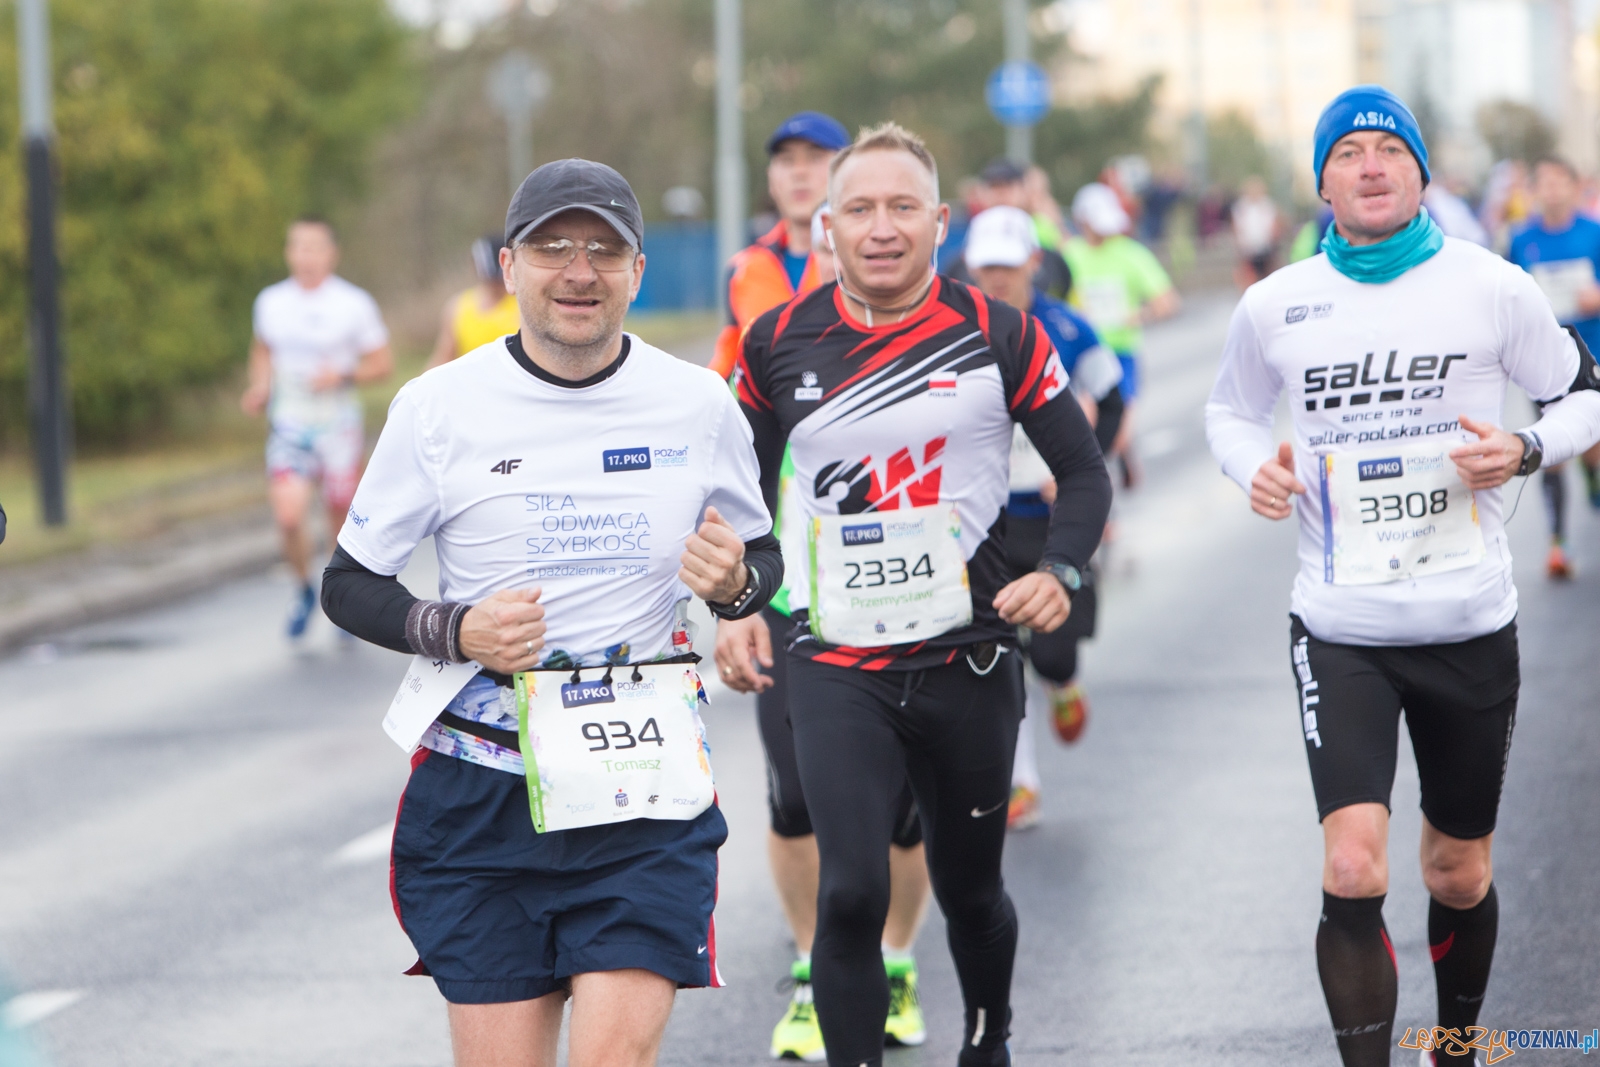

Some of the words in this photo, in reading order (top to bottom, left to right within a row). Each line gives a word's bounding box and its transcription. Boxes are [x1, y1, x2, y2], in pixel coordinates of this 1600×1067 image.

[1353, 111, 1396, 130] ASIA
[1304, 349, 1467, 394] saller
[1390, 406, 1423, 417] 1972
[490, 458, 523, 475] 4F
[655, 455, 688, 466] maraton
[525, 494, 577, 512] SIŁA
[1359, 488, 1449, 524] 3308
[542, 512, 651, 532] ODWAGA
[526, 531, 651, 555] SZYBKOŚĆ
[1377, 524, 1436, 543] Wojciech
[526, 568, 535, 576] 9
[538, 565, 616, 579] października
[620, 564, 649, 576] 2016
[844, 553, 935, 589] 2334
[851, 590, 934, 609] Przemysław
[618, 688, 658, 699] maraton
[1292, 635, 1322, 748] saller
[581, 717, 665, 752] 934
[601, 759, 661, 773] Tomasz
